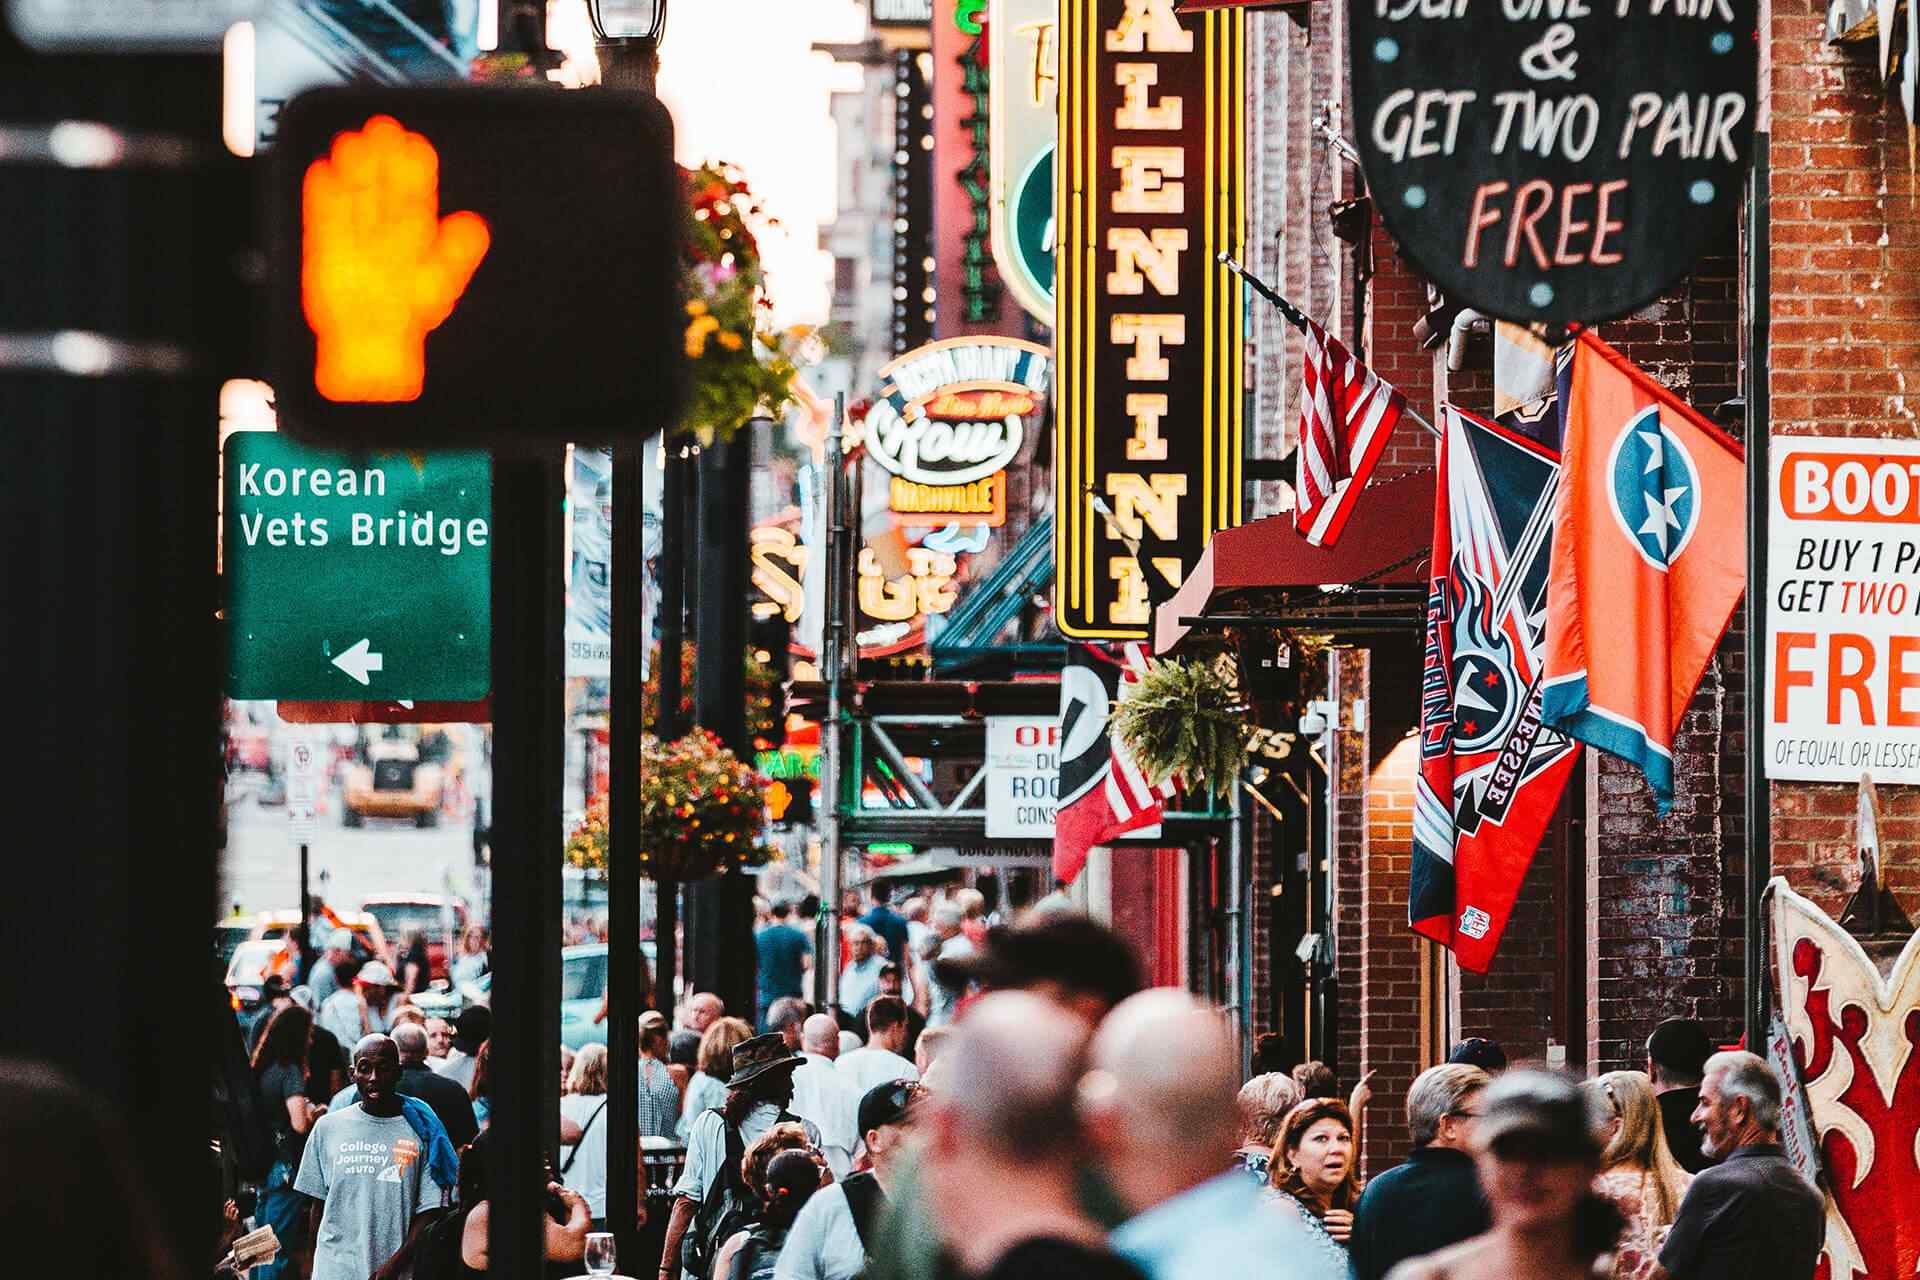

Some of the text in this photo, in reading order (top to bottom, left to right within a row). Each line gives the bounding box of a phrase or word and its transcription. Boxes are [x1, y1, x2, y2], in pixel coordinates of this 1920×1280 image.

[1520, 23, 1579, 81] &
[1371, 88, 1747, 163] GET TWO PAIR
[1461, 178, 1628, 270] FREE
[239, 463, 386, 497] Korean
[1794, 459, 1920, 517] BOO
[240, 510, 490, 556] Vets Bridge
[1795, 537, 1863, 572] BUY
[1871, 541, 1884, 573] 1
[1777, 579, 1834, 613] GET
[1841, 581, 1908, 616] TWO
[1775, 738, 1920, 768] OF EQUAL OR LESSE
[335, 1155, 389, 1167] Journey
[340, 1141, 388, 1154] College
